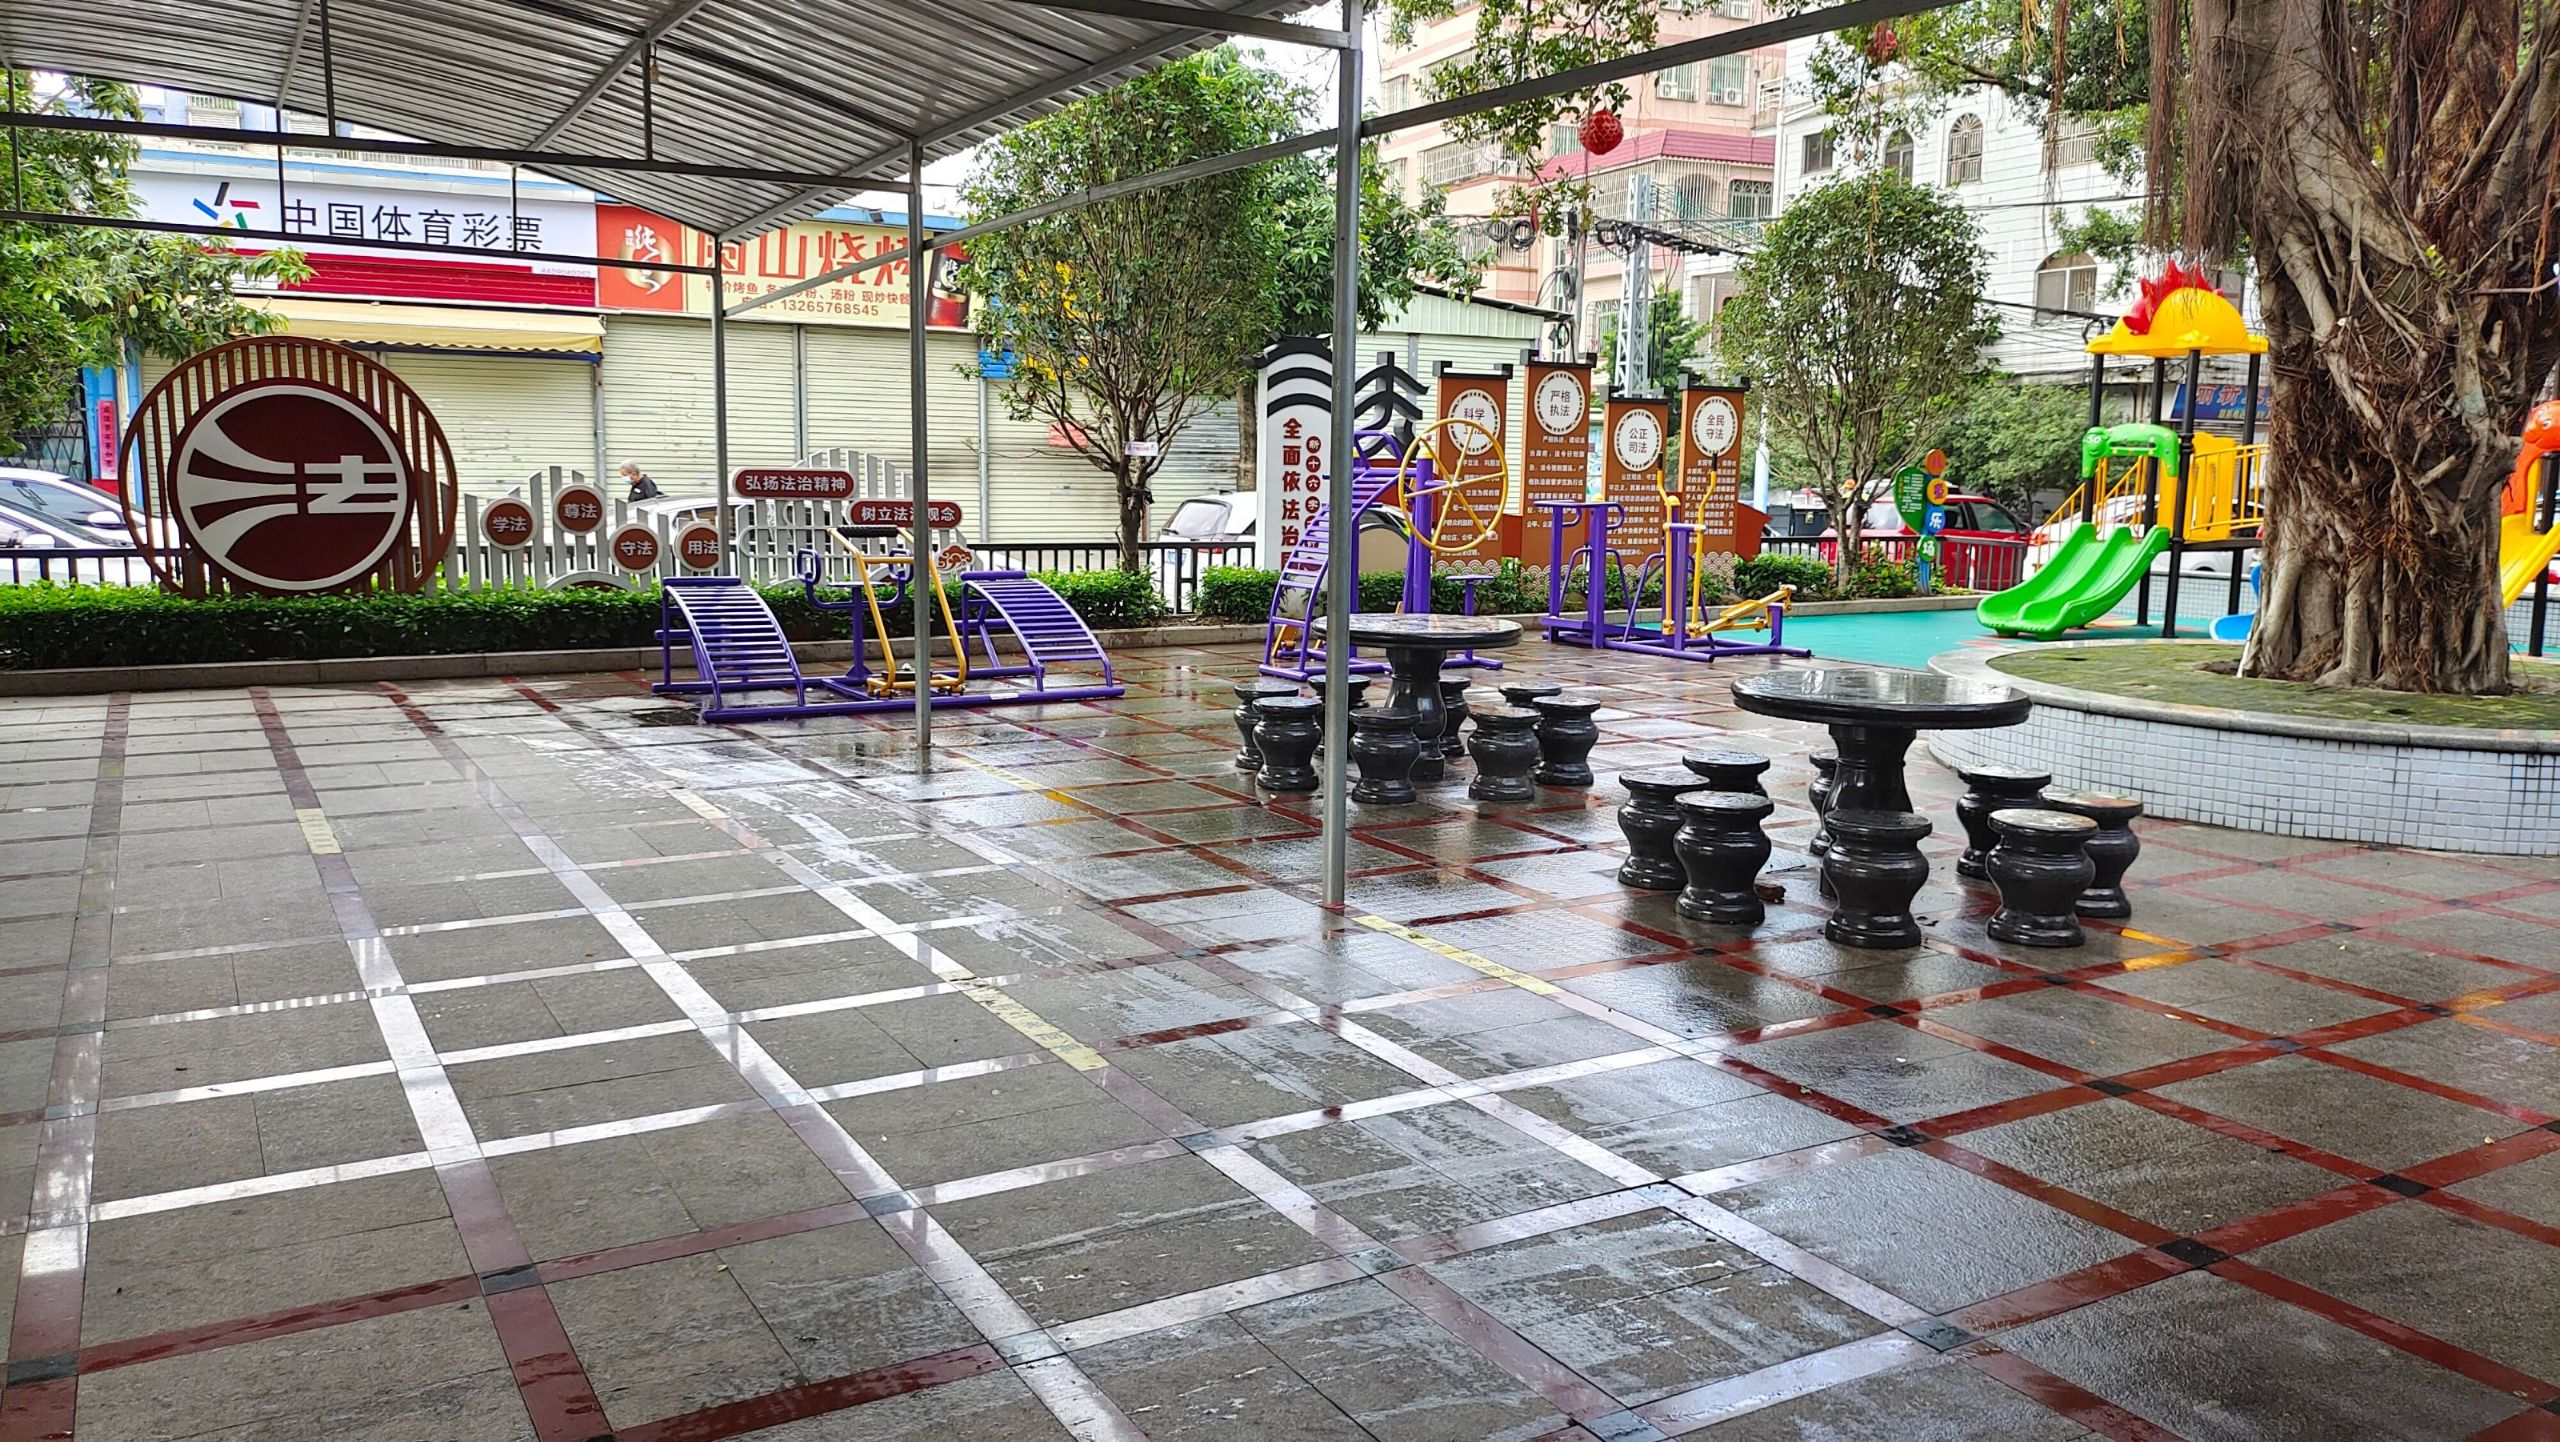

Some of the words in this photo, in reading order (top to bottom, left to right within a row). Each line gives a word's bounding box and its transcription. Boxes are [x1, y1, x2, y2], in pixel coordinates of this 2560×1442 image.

[283, 199, 544, 252] 中国体育彩票
[781, 299, 879, 316] 13265768545
[1550, 390, 1571, 403] 严格
[1464, 407, 1486, 421] 科学
[1549, 404, 1570, 417] 执法
[1706, 414, 1725, 426] 全民
[1629, 428, 1648, 440] 公正
[1706, 427, 1725, 440] 守法
[1628, 441, 1648, 454] 司法
[745, 475, 846, 492] 弘扬法治精神
[563, 503, 598, 520] 尊法
[492, 516, 527, 533] 学法
[620, 541, 653, 556] 守法
[688, 540, 719, 555] 用法
